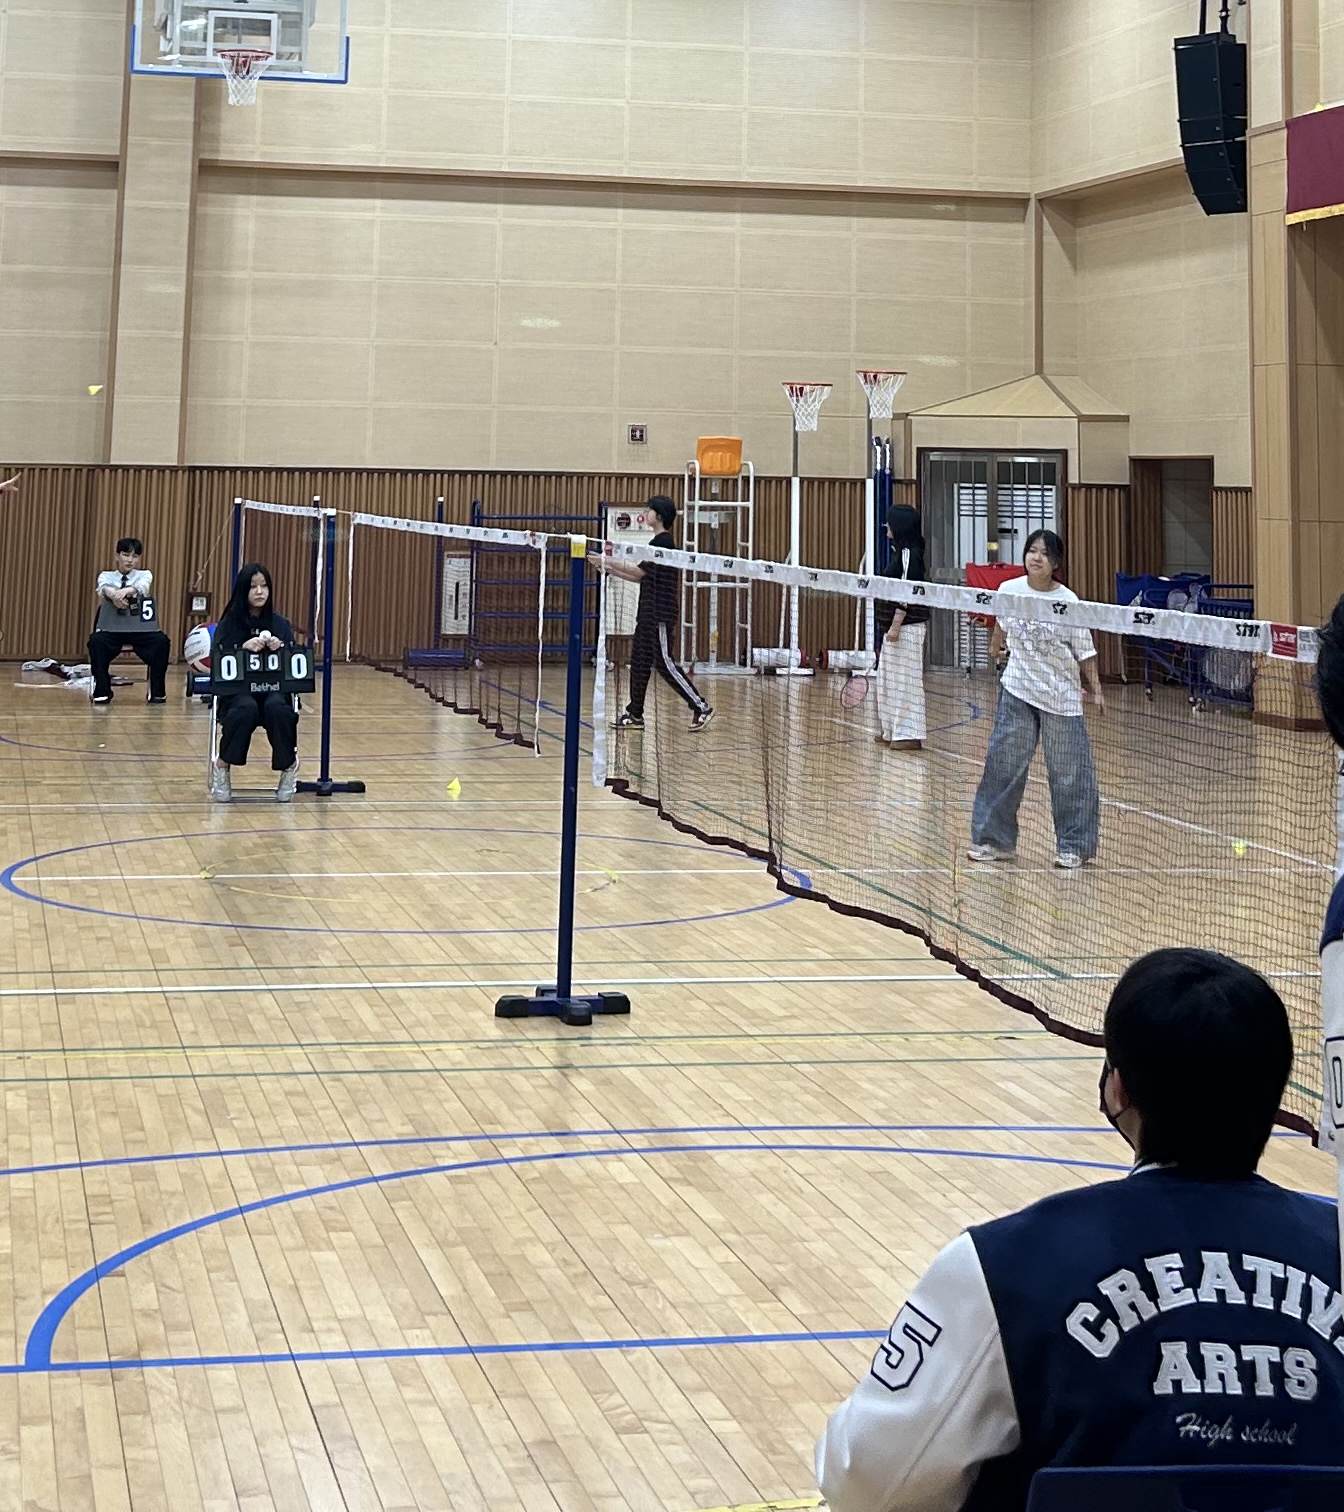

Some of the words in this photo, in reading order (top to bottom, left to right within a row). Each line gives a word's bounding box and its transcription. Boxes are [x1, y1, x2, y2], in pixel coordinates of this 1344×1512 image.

[142, 600, 153, 619] 5
[221, 655, 237, 680] 0
[249, 654, 260, 669] 5
[268, 654, 278, 669] 0
[291, 653, 307, 679] 0
[871, 1301, 942, 1392] 5
[1152, 1340, 1319, 1401] ARTS
[1175, 1411, 1234, 1445] High
[1240, 1418, 1297, 1445] school
